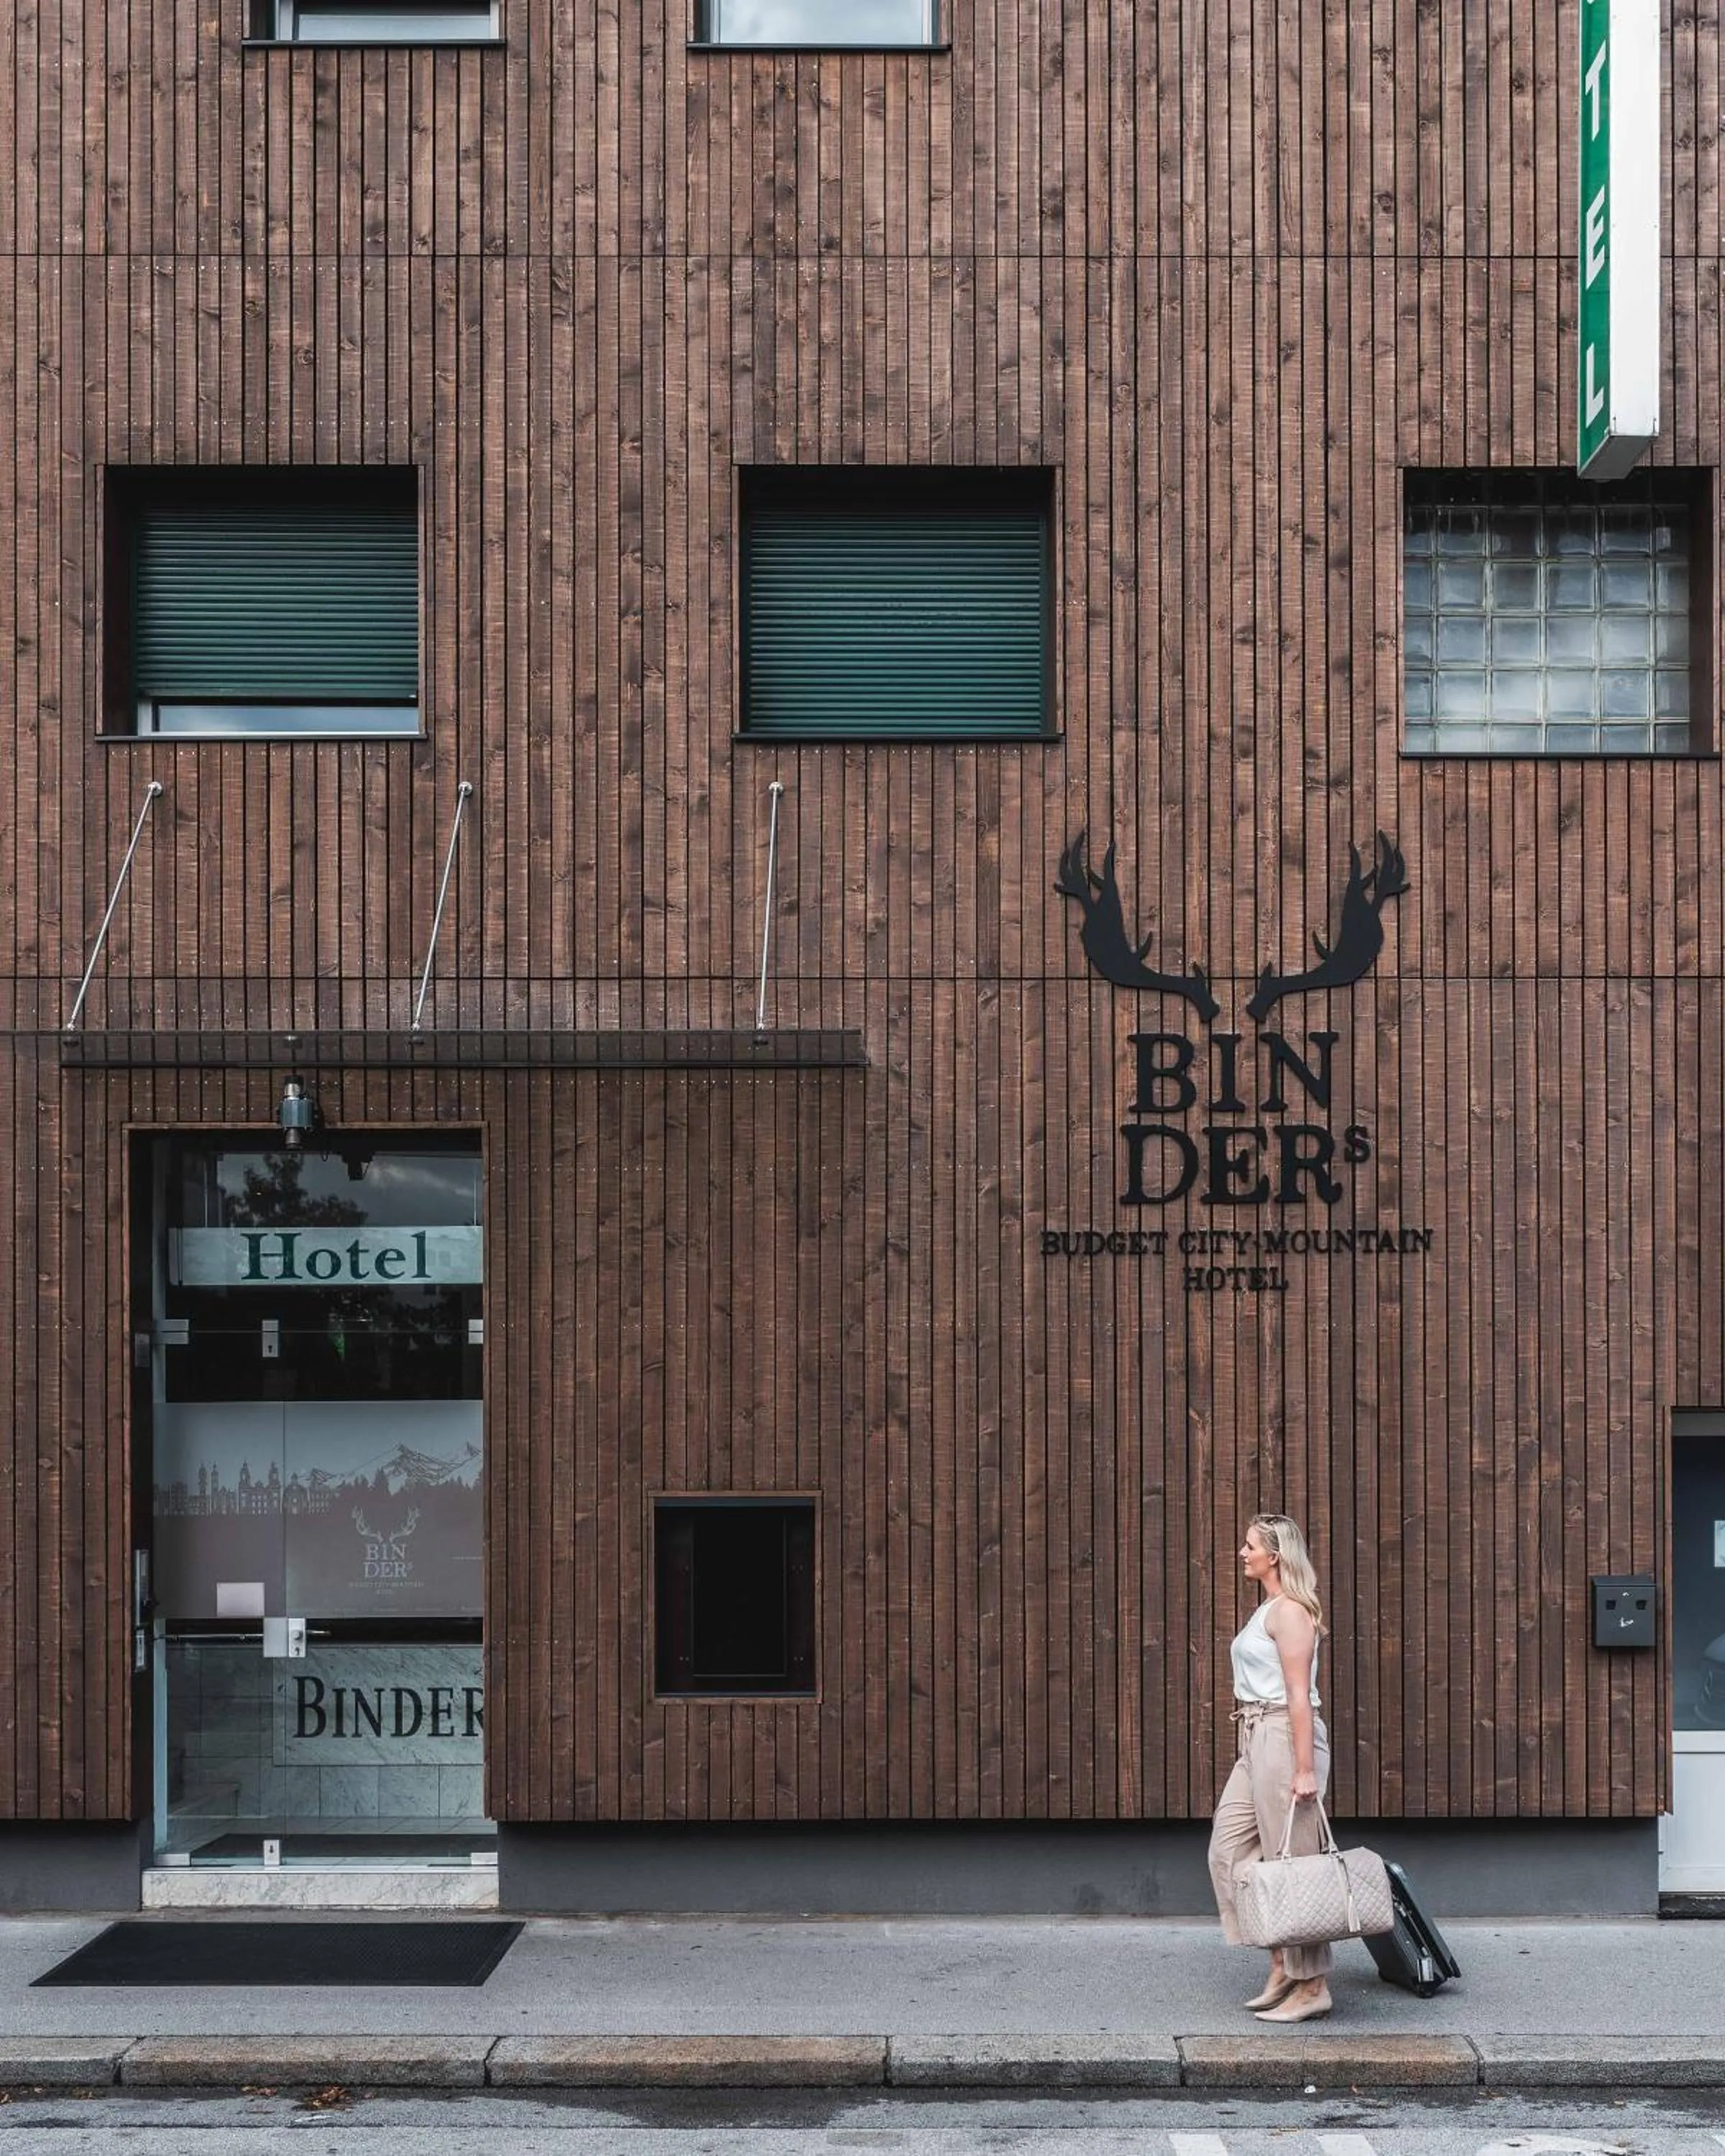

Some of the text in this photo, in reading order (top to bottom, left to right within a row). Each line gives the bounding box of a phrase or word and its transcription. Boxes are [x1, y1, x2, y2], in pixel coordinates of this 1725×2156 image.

[1585, 0, 1607, 428] TEL
[1127, 1031, 1340, 1112] BIN
[240, 1230, 431, 1281] Hotel
[1041, 1230, 1169, 1256] BUDGET
[1182, 1266, 1289, 1291] HOTEL
[365, 1543, 407, 1560] BIN
[293, 1676, 483, 1738] BINDER
